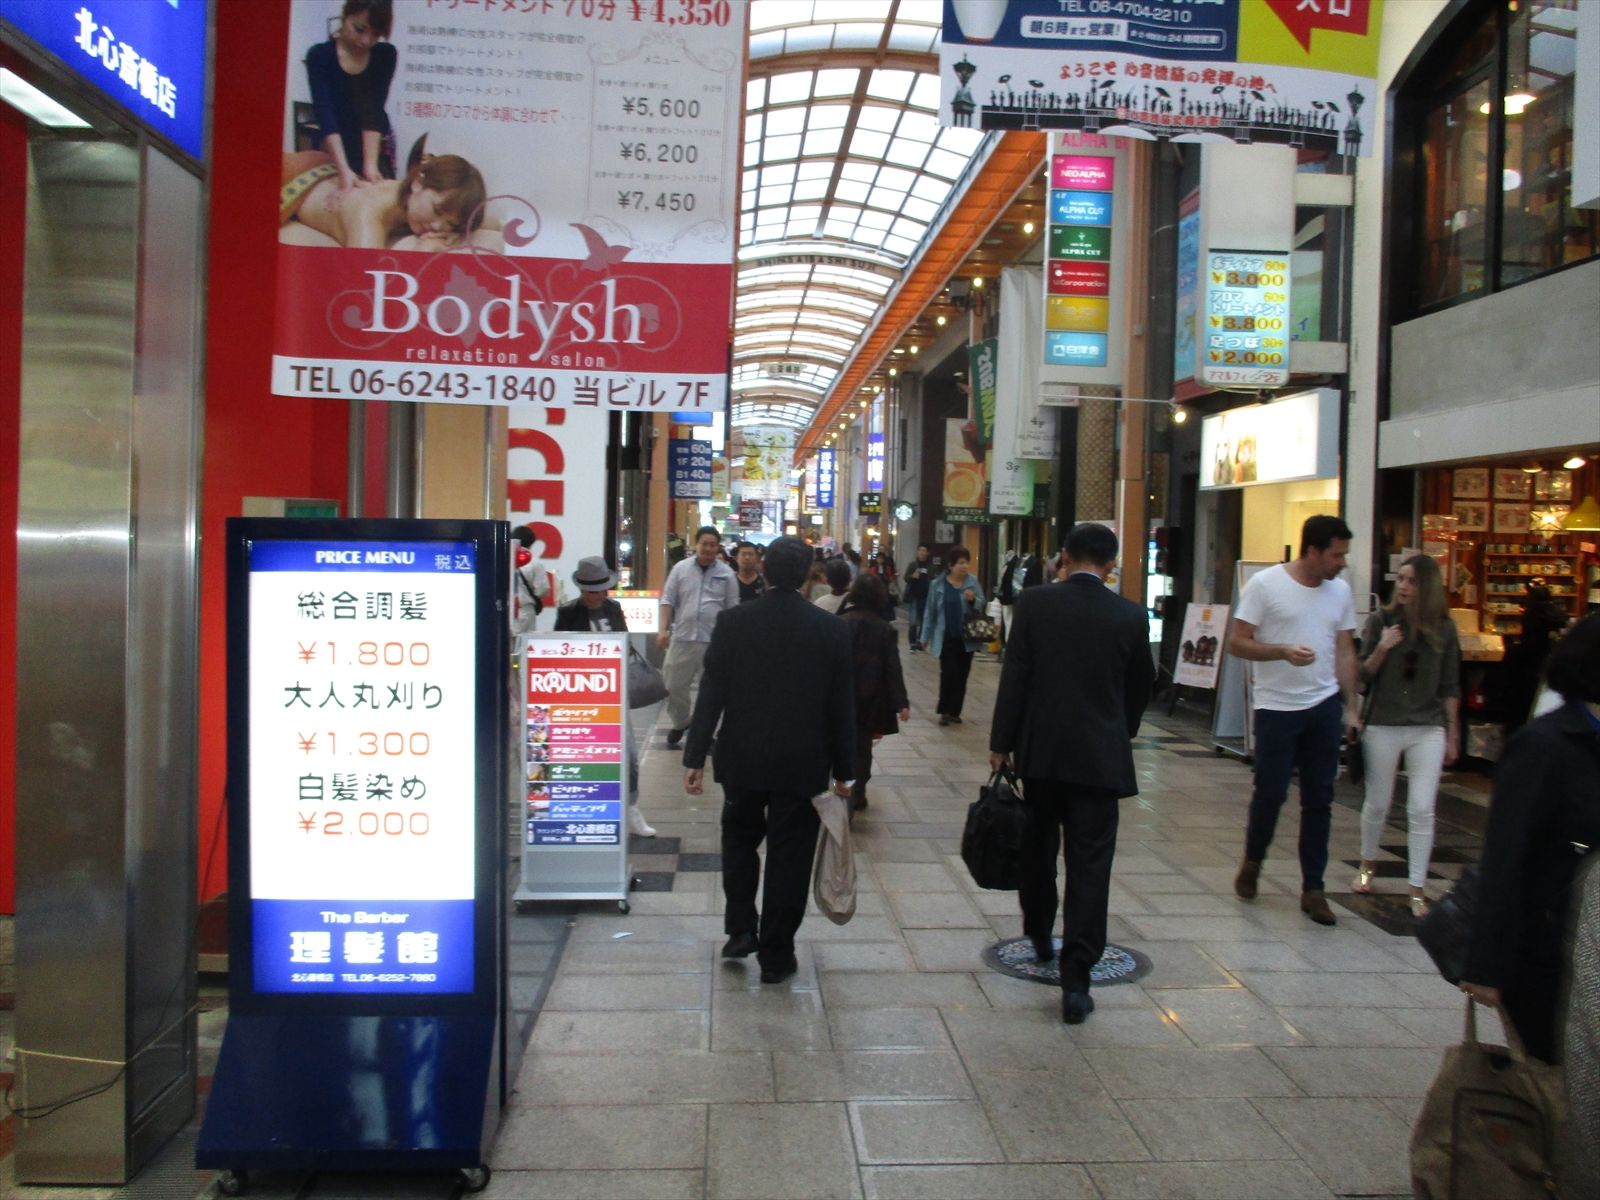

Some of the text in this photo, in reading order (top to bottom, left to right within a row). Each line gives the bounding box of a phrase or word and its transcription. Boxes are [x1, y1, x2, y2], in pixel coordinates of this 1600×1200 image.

[627, 0, 731, 27] ¥4,350
[1058, 0, 1192, 23] TEL 06-4704-2210
[1059, 61, 1117, 80] ようこそ
[1210, 291, 1243, 303] アロマ
[361, 270, 646, 361] Bodysh
[405, 346, 606, 368] relaxation salon
[290, 365, 341, 393] TEL
[349, 367, 556, 402] 06-6243-1840
[676, 381, 710, 408] 7F
[315, 551, 471, 570] PRICE MENU 税込
[297, 591, 428, 620] 総合調髪
[531, 668, 617, 694] ROUND1
[284, 681, 443, 710] 大人丸刈り
[299, 772, 427, 801] 白髪染め
[320, 911, 409, 924] The Barber
